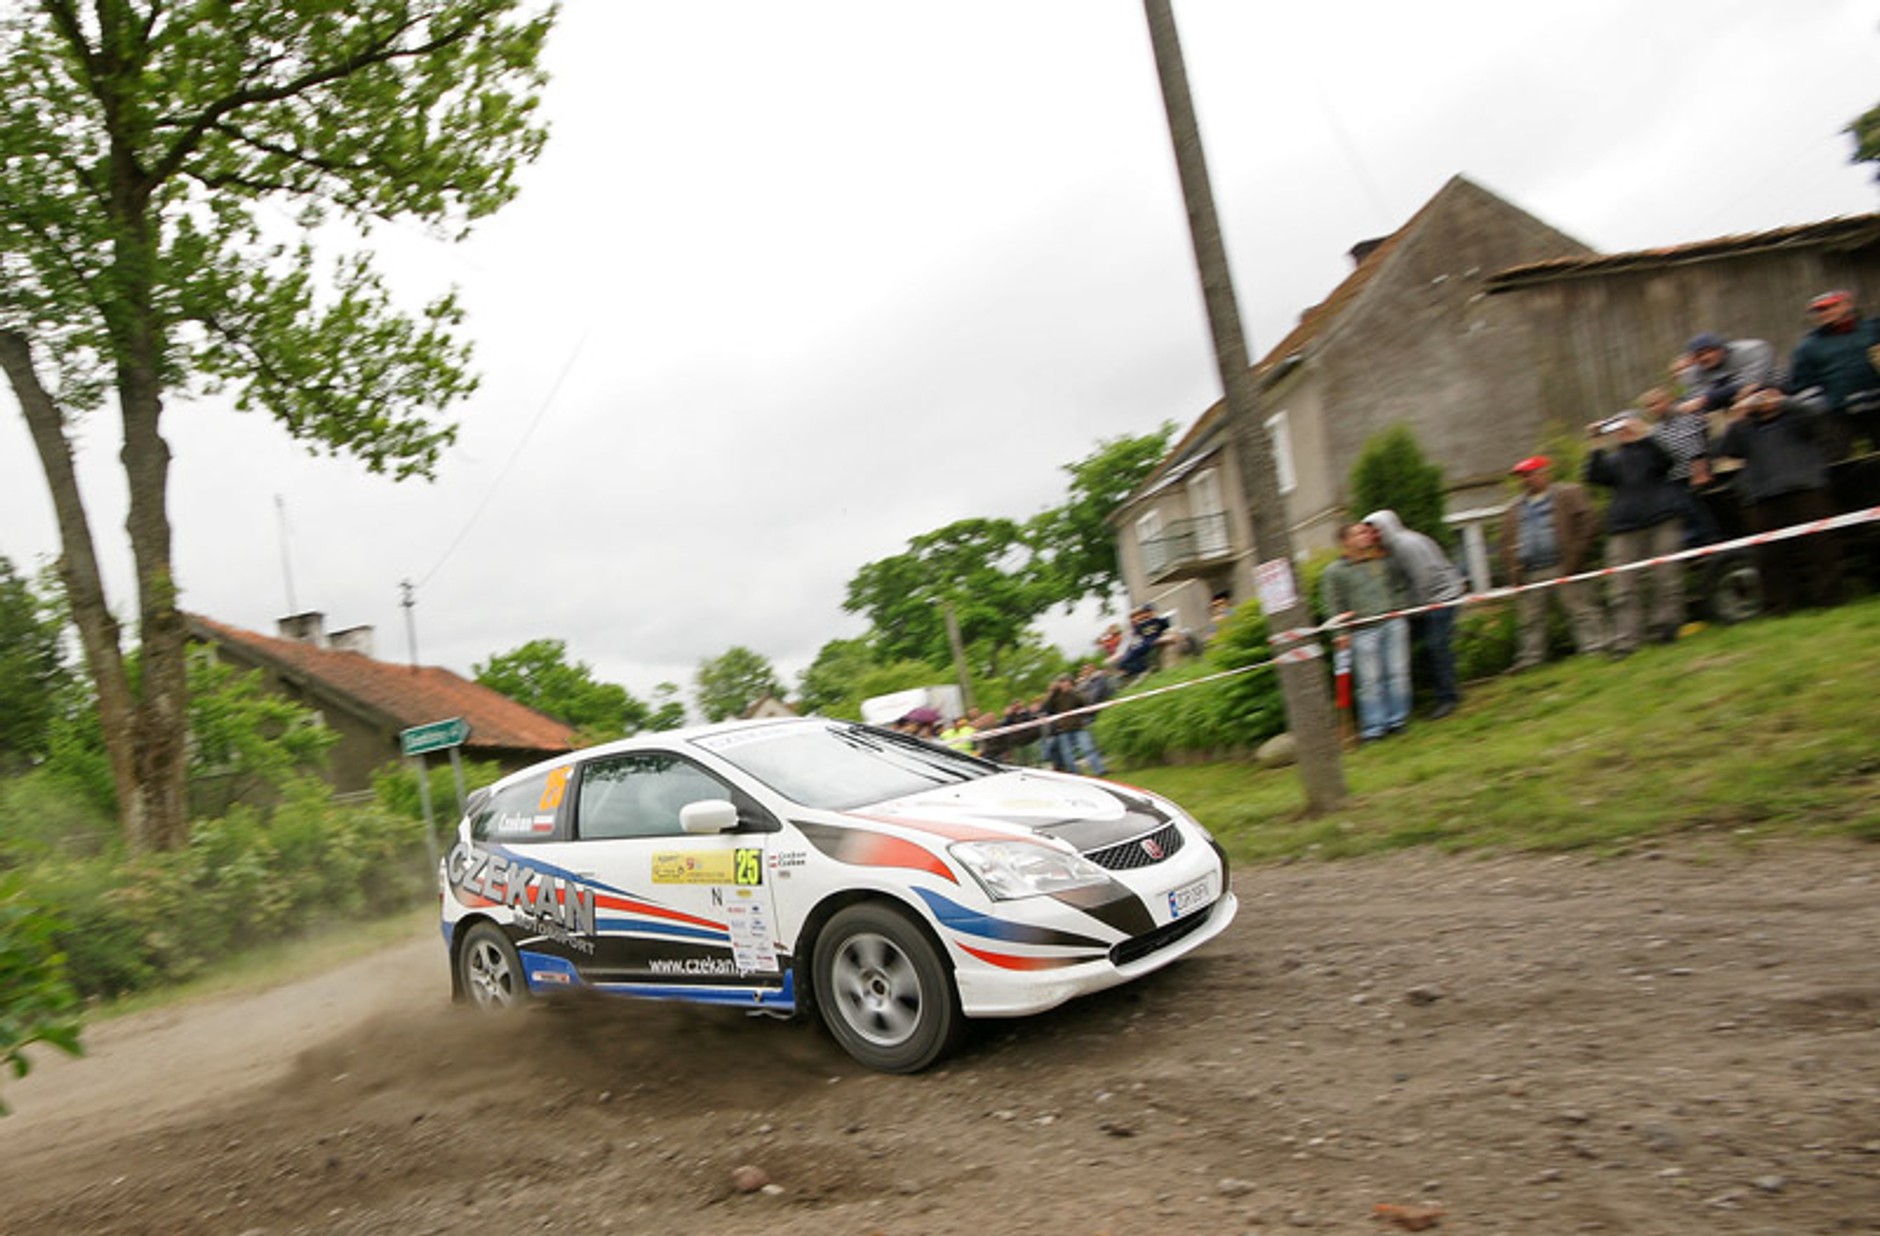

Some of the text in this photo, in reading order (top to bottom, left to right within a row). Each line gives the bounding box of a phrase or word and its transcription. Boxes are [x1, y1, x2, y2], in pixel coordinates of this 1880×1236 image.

[737, 849, 759, 884] 25
[449, 842, 596, 936] CZEKAN
[711, 888, 723, 906] N
